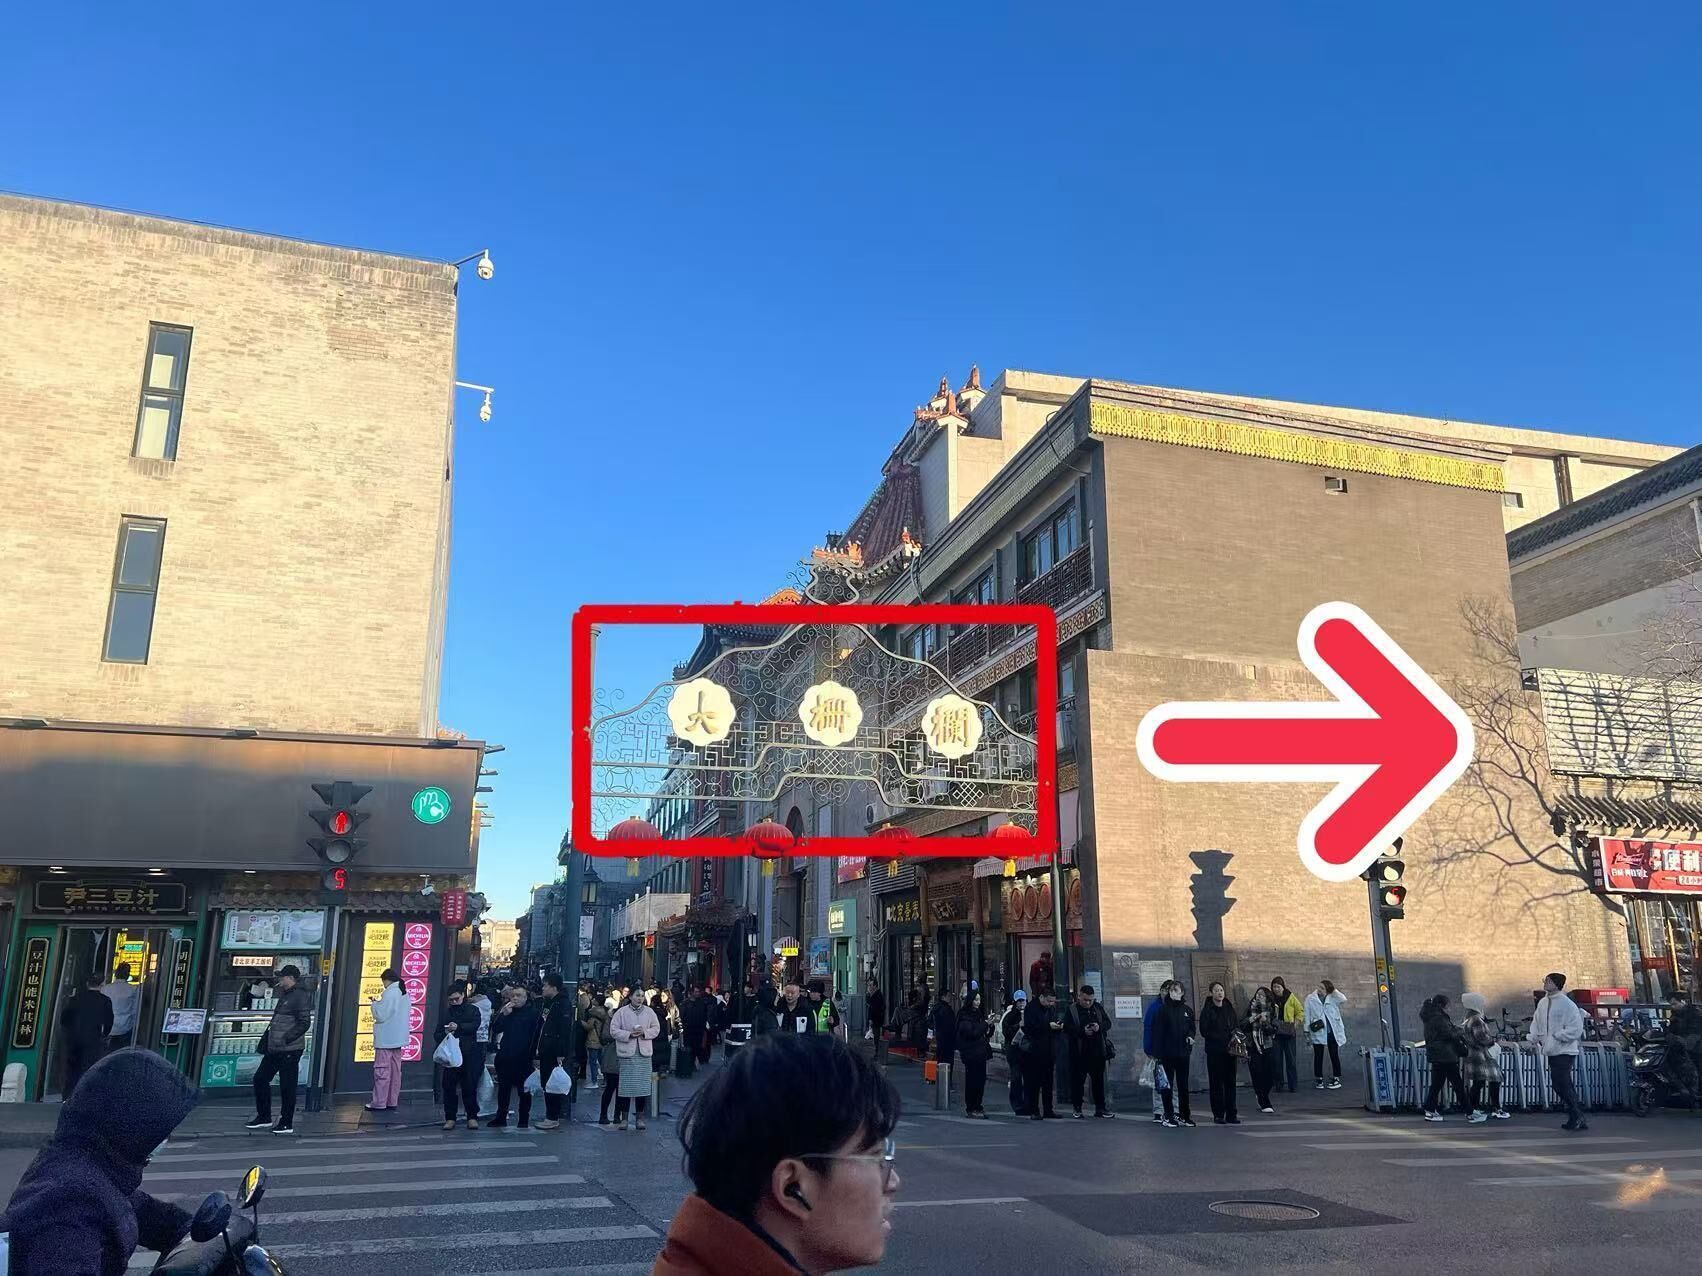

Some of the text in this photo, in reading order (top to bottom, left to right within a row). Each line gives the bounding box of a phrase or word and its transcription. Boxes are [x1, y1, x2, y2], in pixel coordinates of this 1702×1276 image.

[335, 869, 345, 889] 5
[64, 887, 159, 905] 尹三豆汁
[19, 950, 43, 1035] 豆汁也能米其林
